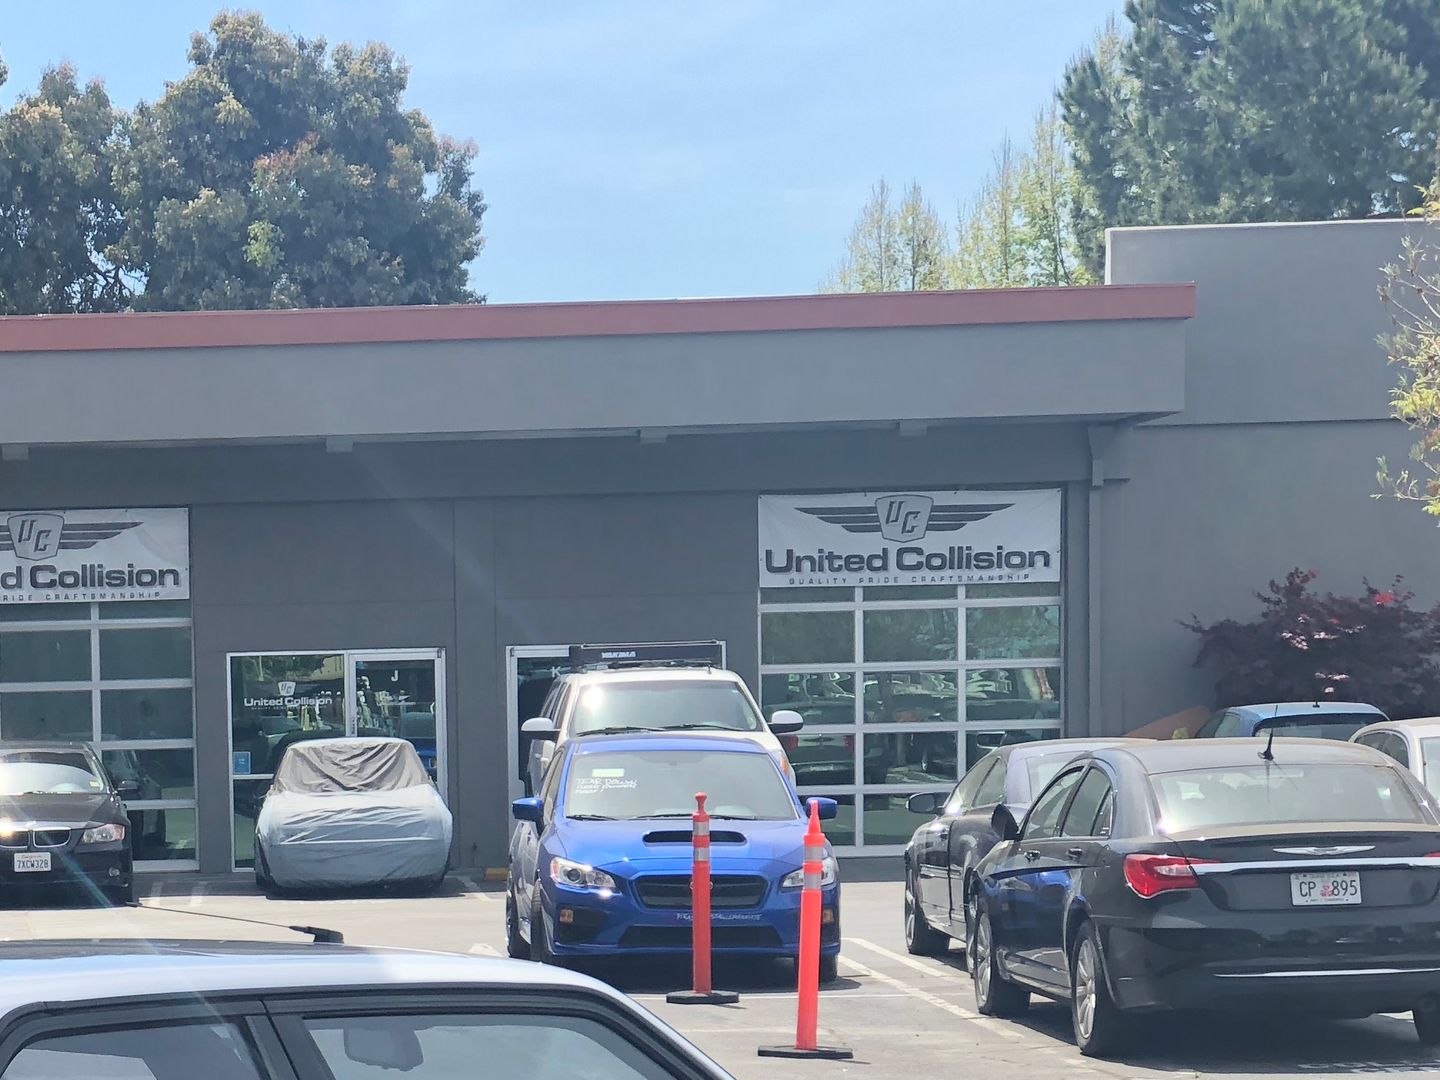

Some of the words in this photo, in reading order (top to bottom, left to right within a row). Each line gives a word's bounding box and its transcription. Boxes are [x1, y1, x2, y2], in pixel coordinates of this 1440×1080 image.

[765, 548, 889, 574] United
[896, 545, 1051, 571] Collision
[29, 563, 181, 589] Collision
[789, 577, 848, 586] QUALITY
[858, 576, 899, 584] PRIDE
[911, 573, 1031, 583] CRAFTSMANSHIP
[45, 591, 161, 602] CRAFTSMANSHIP
[243, 698, 282, 707] United
[284, 697, 333, 706] Collision
[16, 859, 49, 869] 7XCW328
[1299, 880, 1317, 897] CP
[1331, 879, 1358, 897] 895
